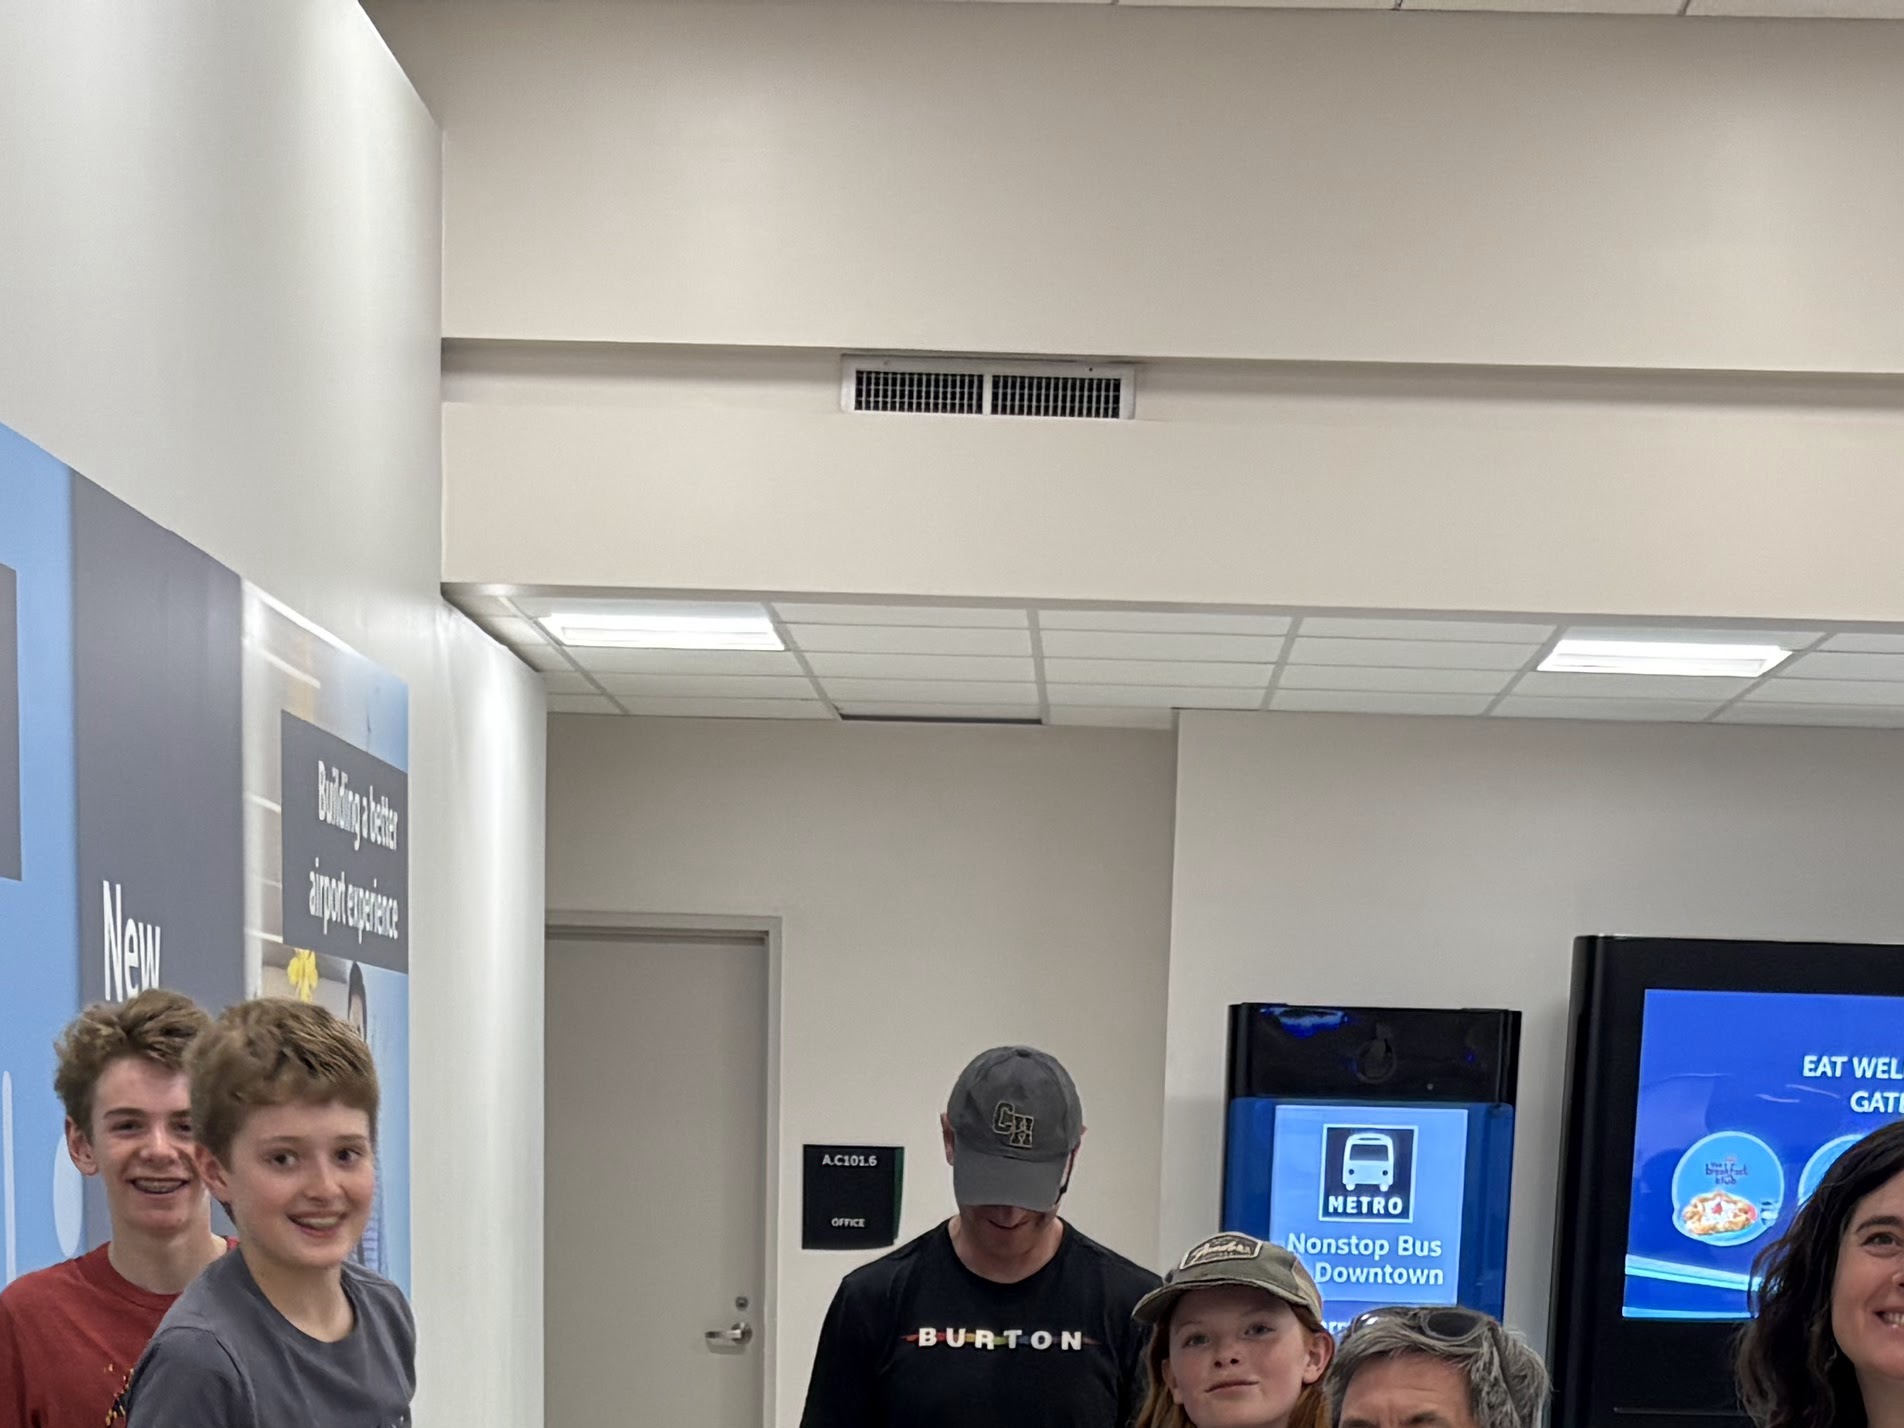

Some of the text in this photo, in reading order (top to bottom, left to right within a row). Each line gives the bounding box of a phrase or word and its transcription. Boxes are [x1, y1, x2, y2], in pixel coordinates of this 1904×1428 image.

[318, 760, 361, 851] Building
[370, 785, 398, 850] better
[309, 857, 398, 944] airport experience
[102, 880, 162, 1001] New
[1803, 1055, 1848, 1078] EAT
[1328, 1195, 1403, 1215] METRO
[831, 1218, 865, 1227] OFFICE
[1287, 1233, 1442, 1261] Nonstop Bus
[1314, 1262, 1444, 1285] Downtown
[918, 1327, 1084, 1350] BURTON
